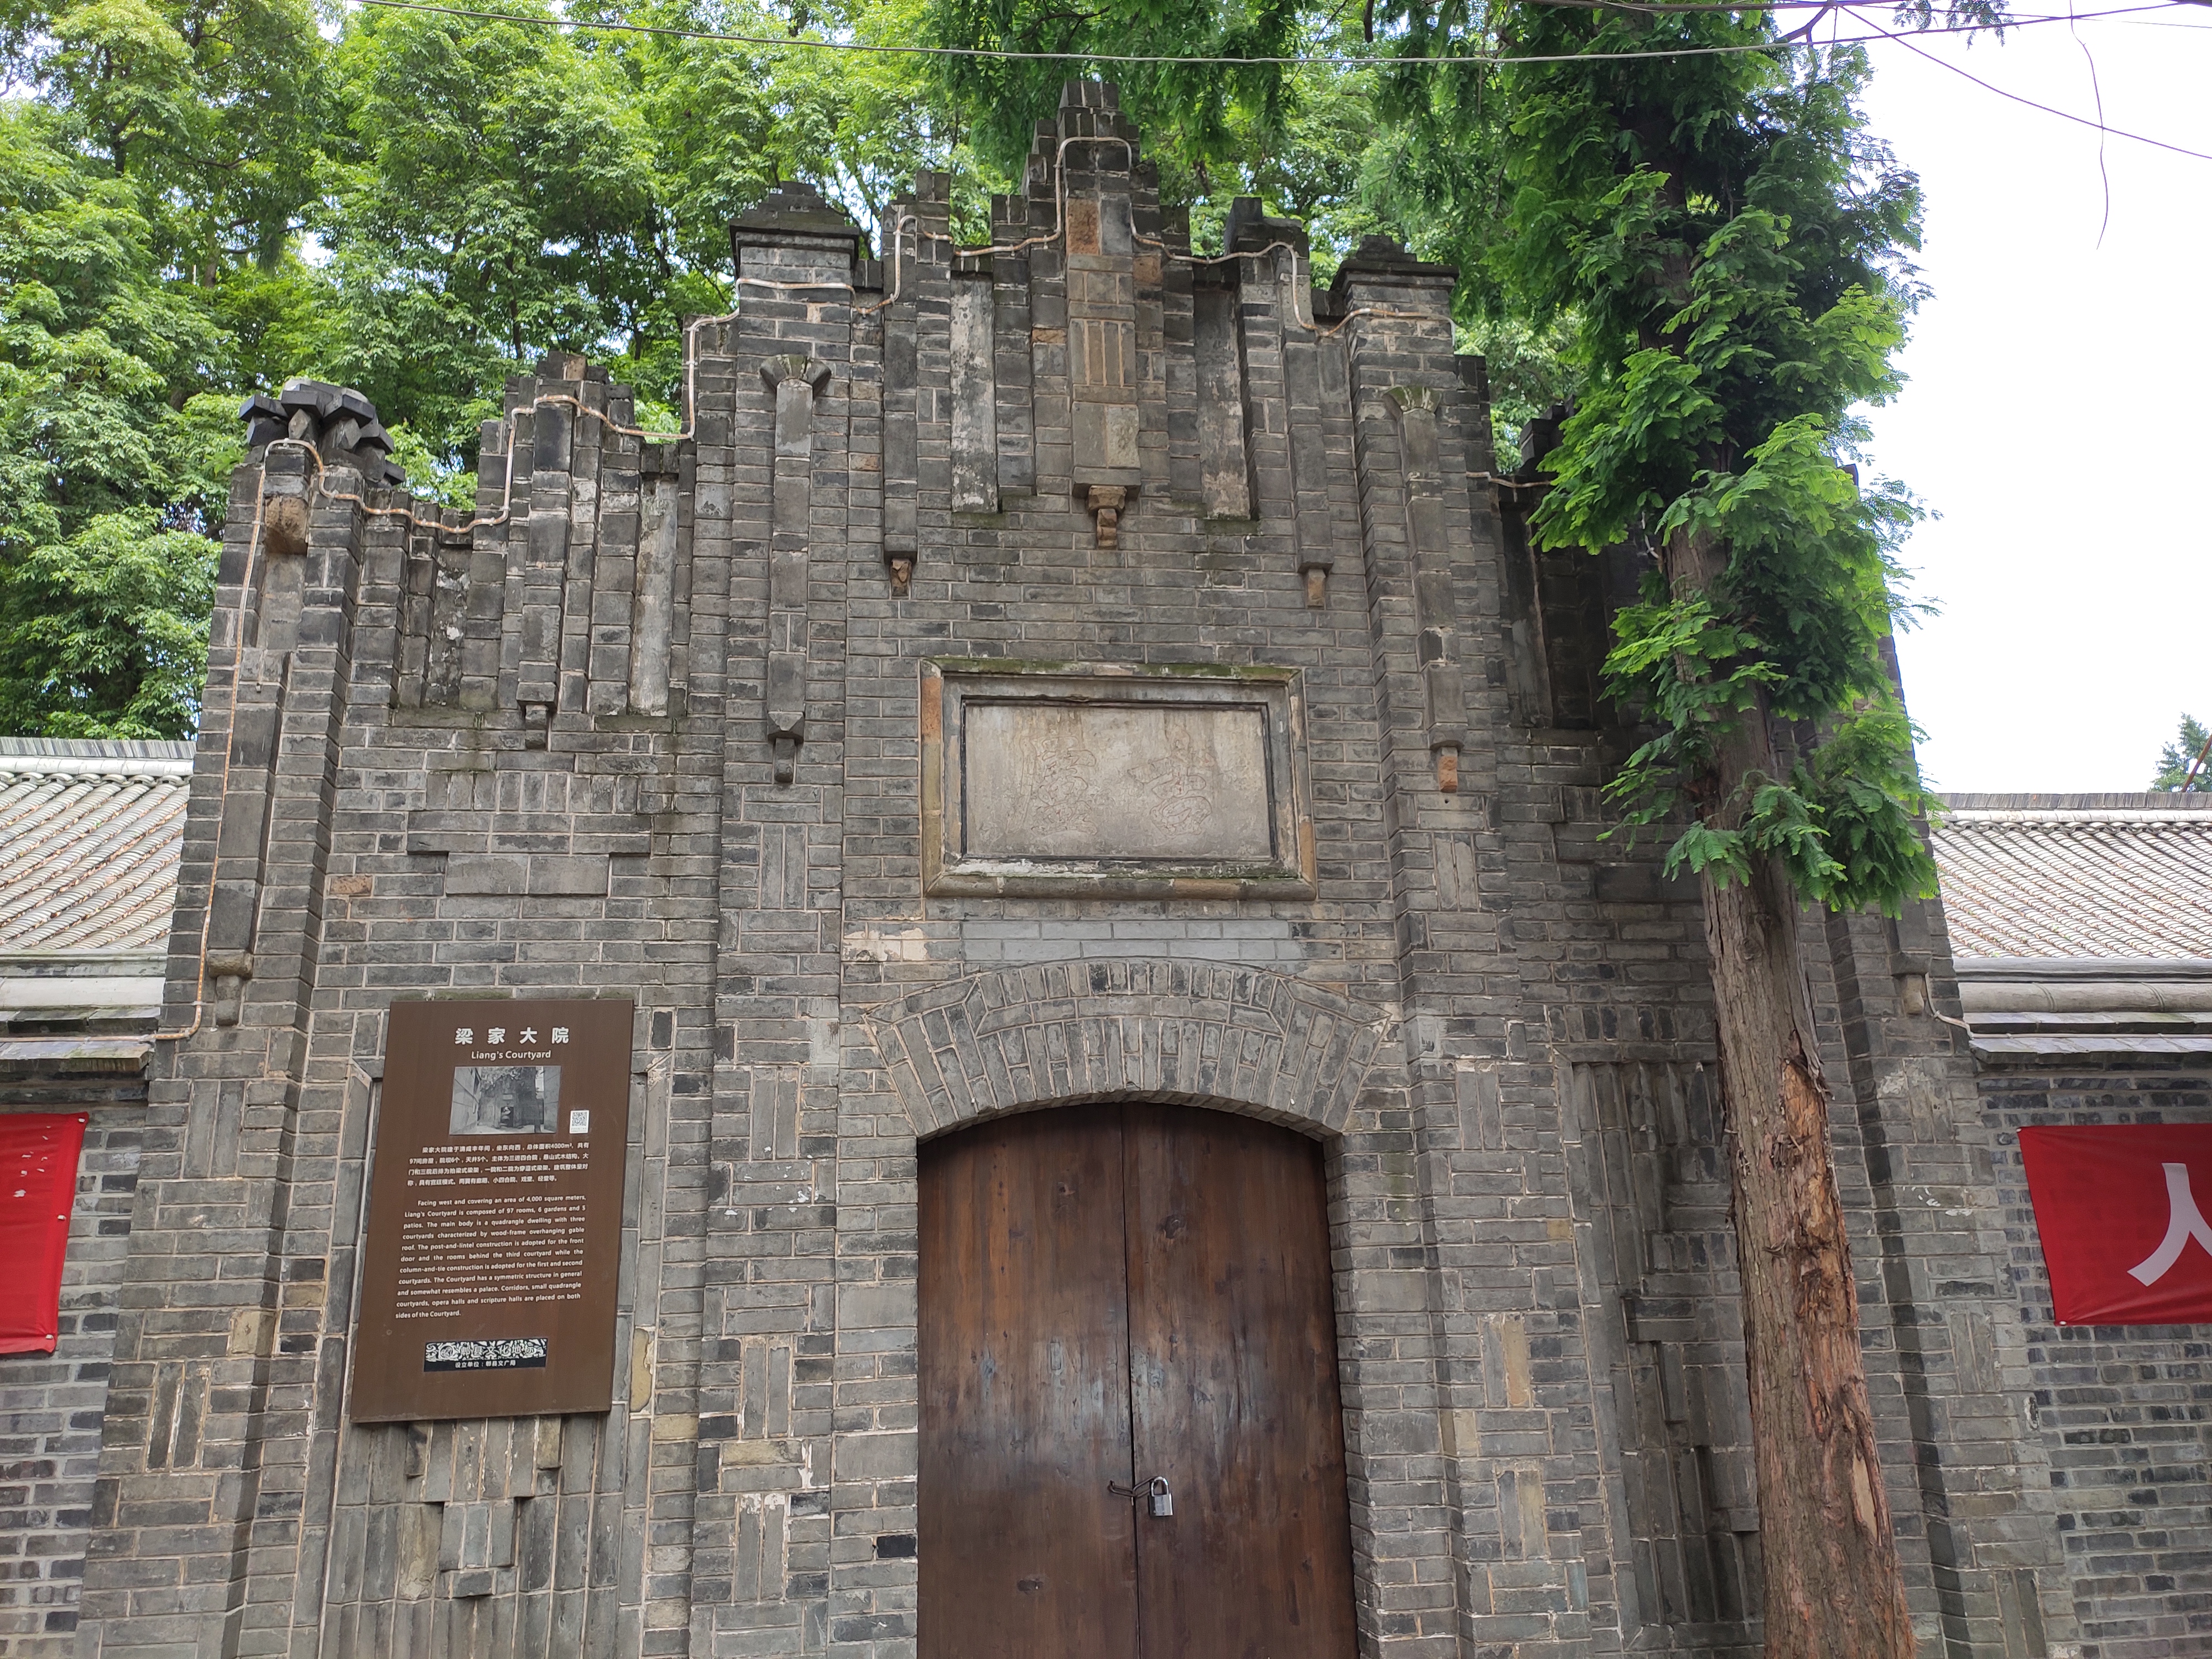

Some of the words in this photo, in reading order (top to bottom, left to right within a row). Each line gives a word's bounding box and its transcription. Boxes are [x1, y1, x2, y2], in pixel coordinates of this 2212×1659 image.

[455, 1026, 570, 1045] 梁家大院
[471, 1051, 503, 1061] Liang's
[505, 1050, 551, 1060] Courtyard
[494, 1273, 524, 1281] symmetric
[560, 1270, 582, 1279] general
[548, 1281, 581, 1290] quadrangle
